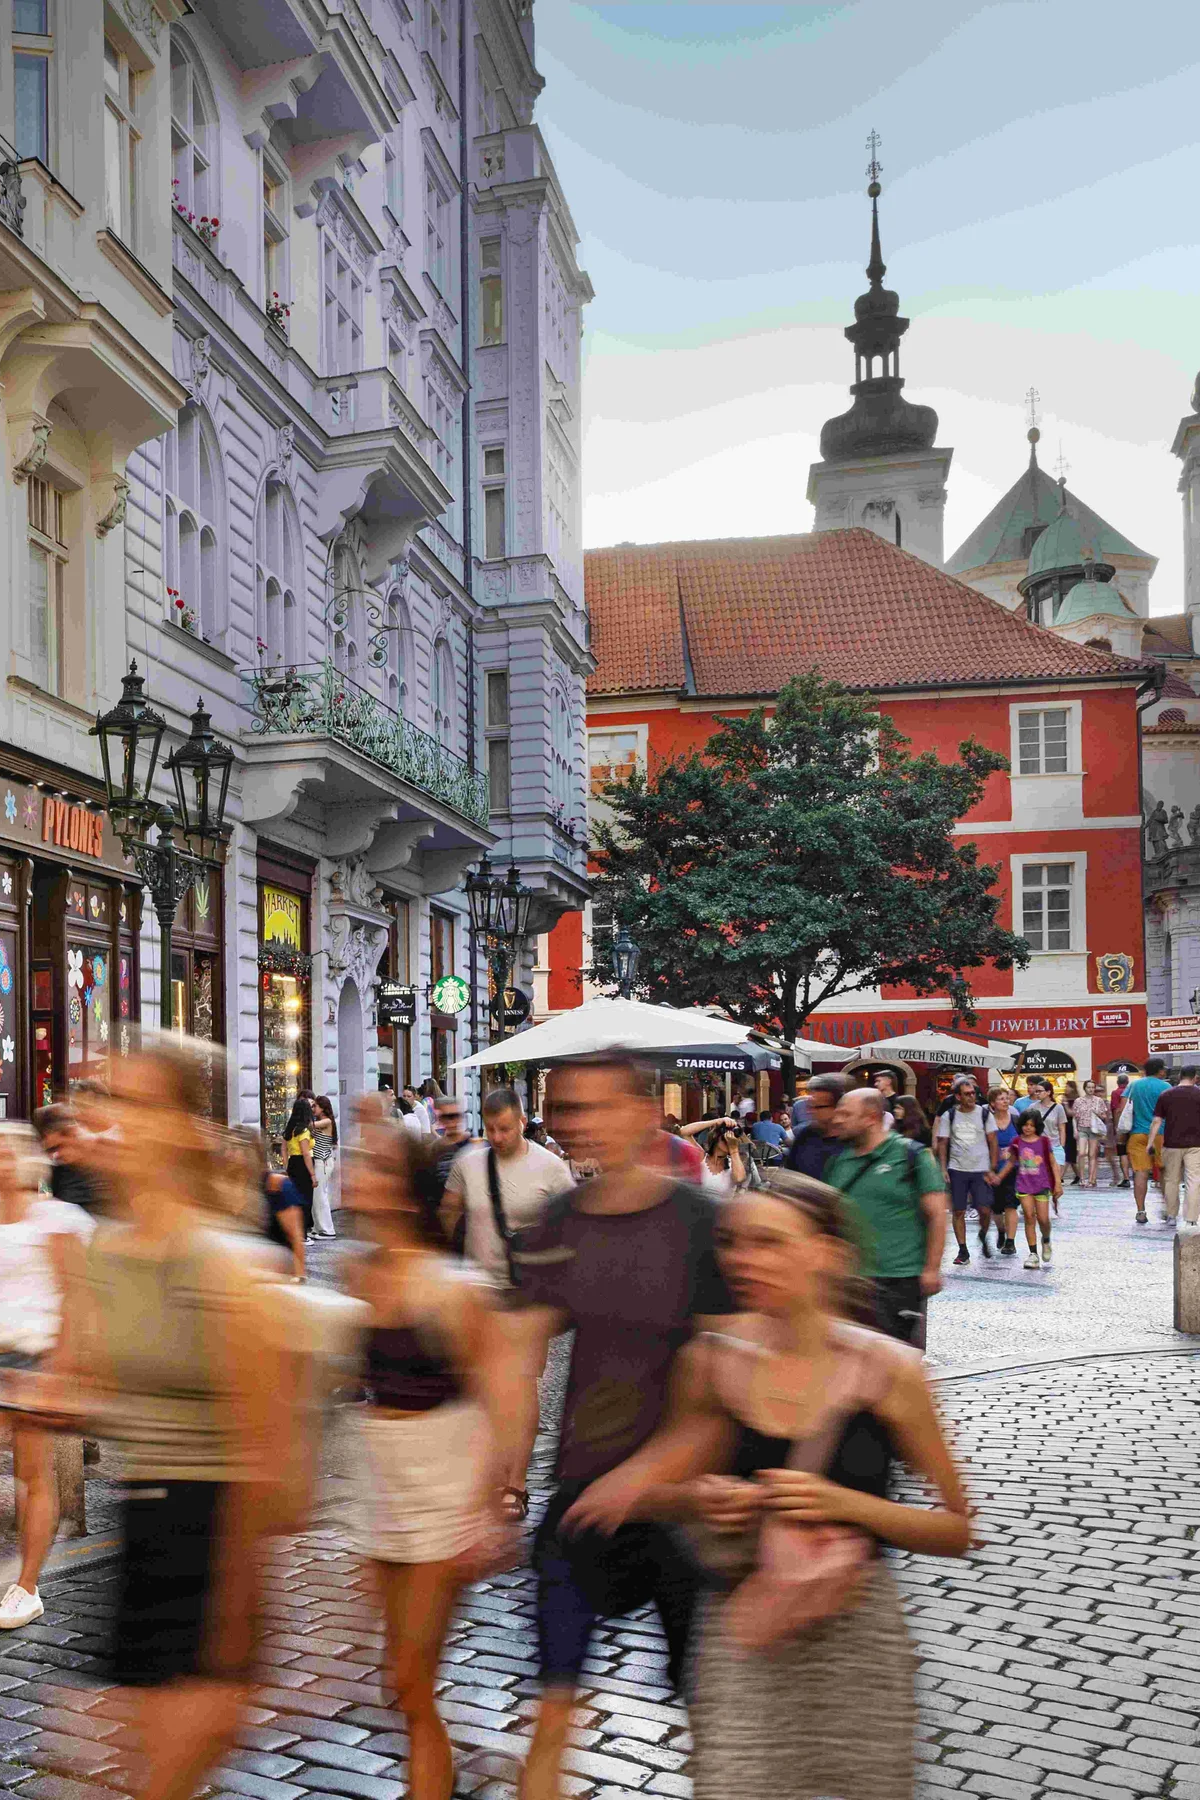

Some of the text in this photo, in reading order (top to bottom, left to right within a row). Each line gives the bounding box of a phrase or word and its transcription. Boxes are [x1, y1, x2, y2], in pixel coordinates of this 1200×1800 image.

[42, 797, 104, 858] PYLONES
[264, 893, 300, 934] MARKET
[988, 1017, 1091, 1033] JEWELLERY
[676, 1058, 746, 1070] STARBUCKS
[898, 1050, 986, 1067] CZECH RESTAURANT
